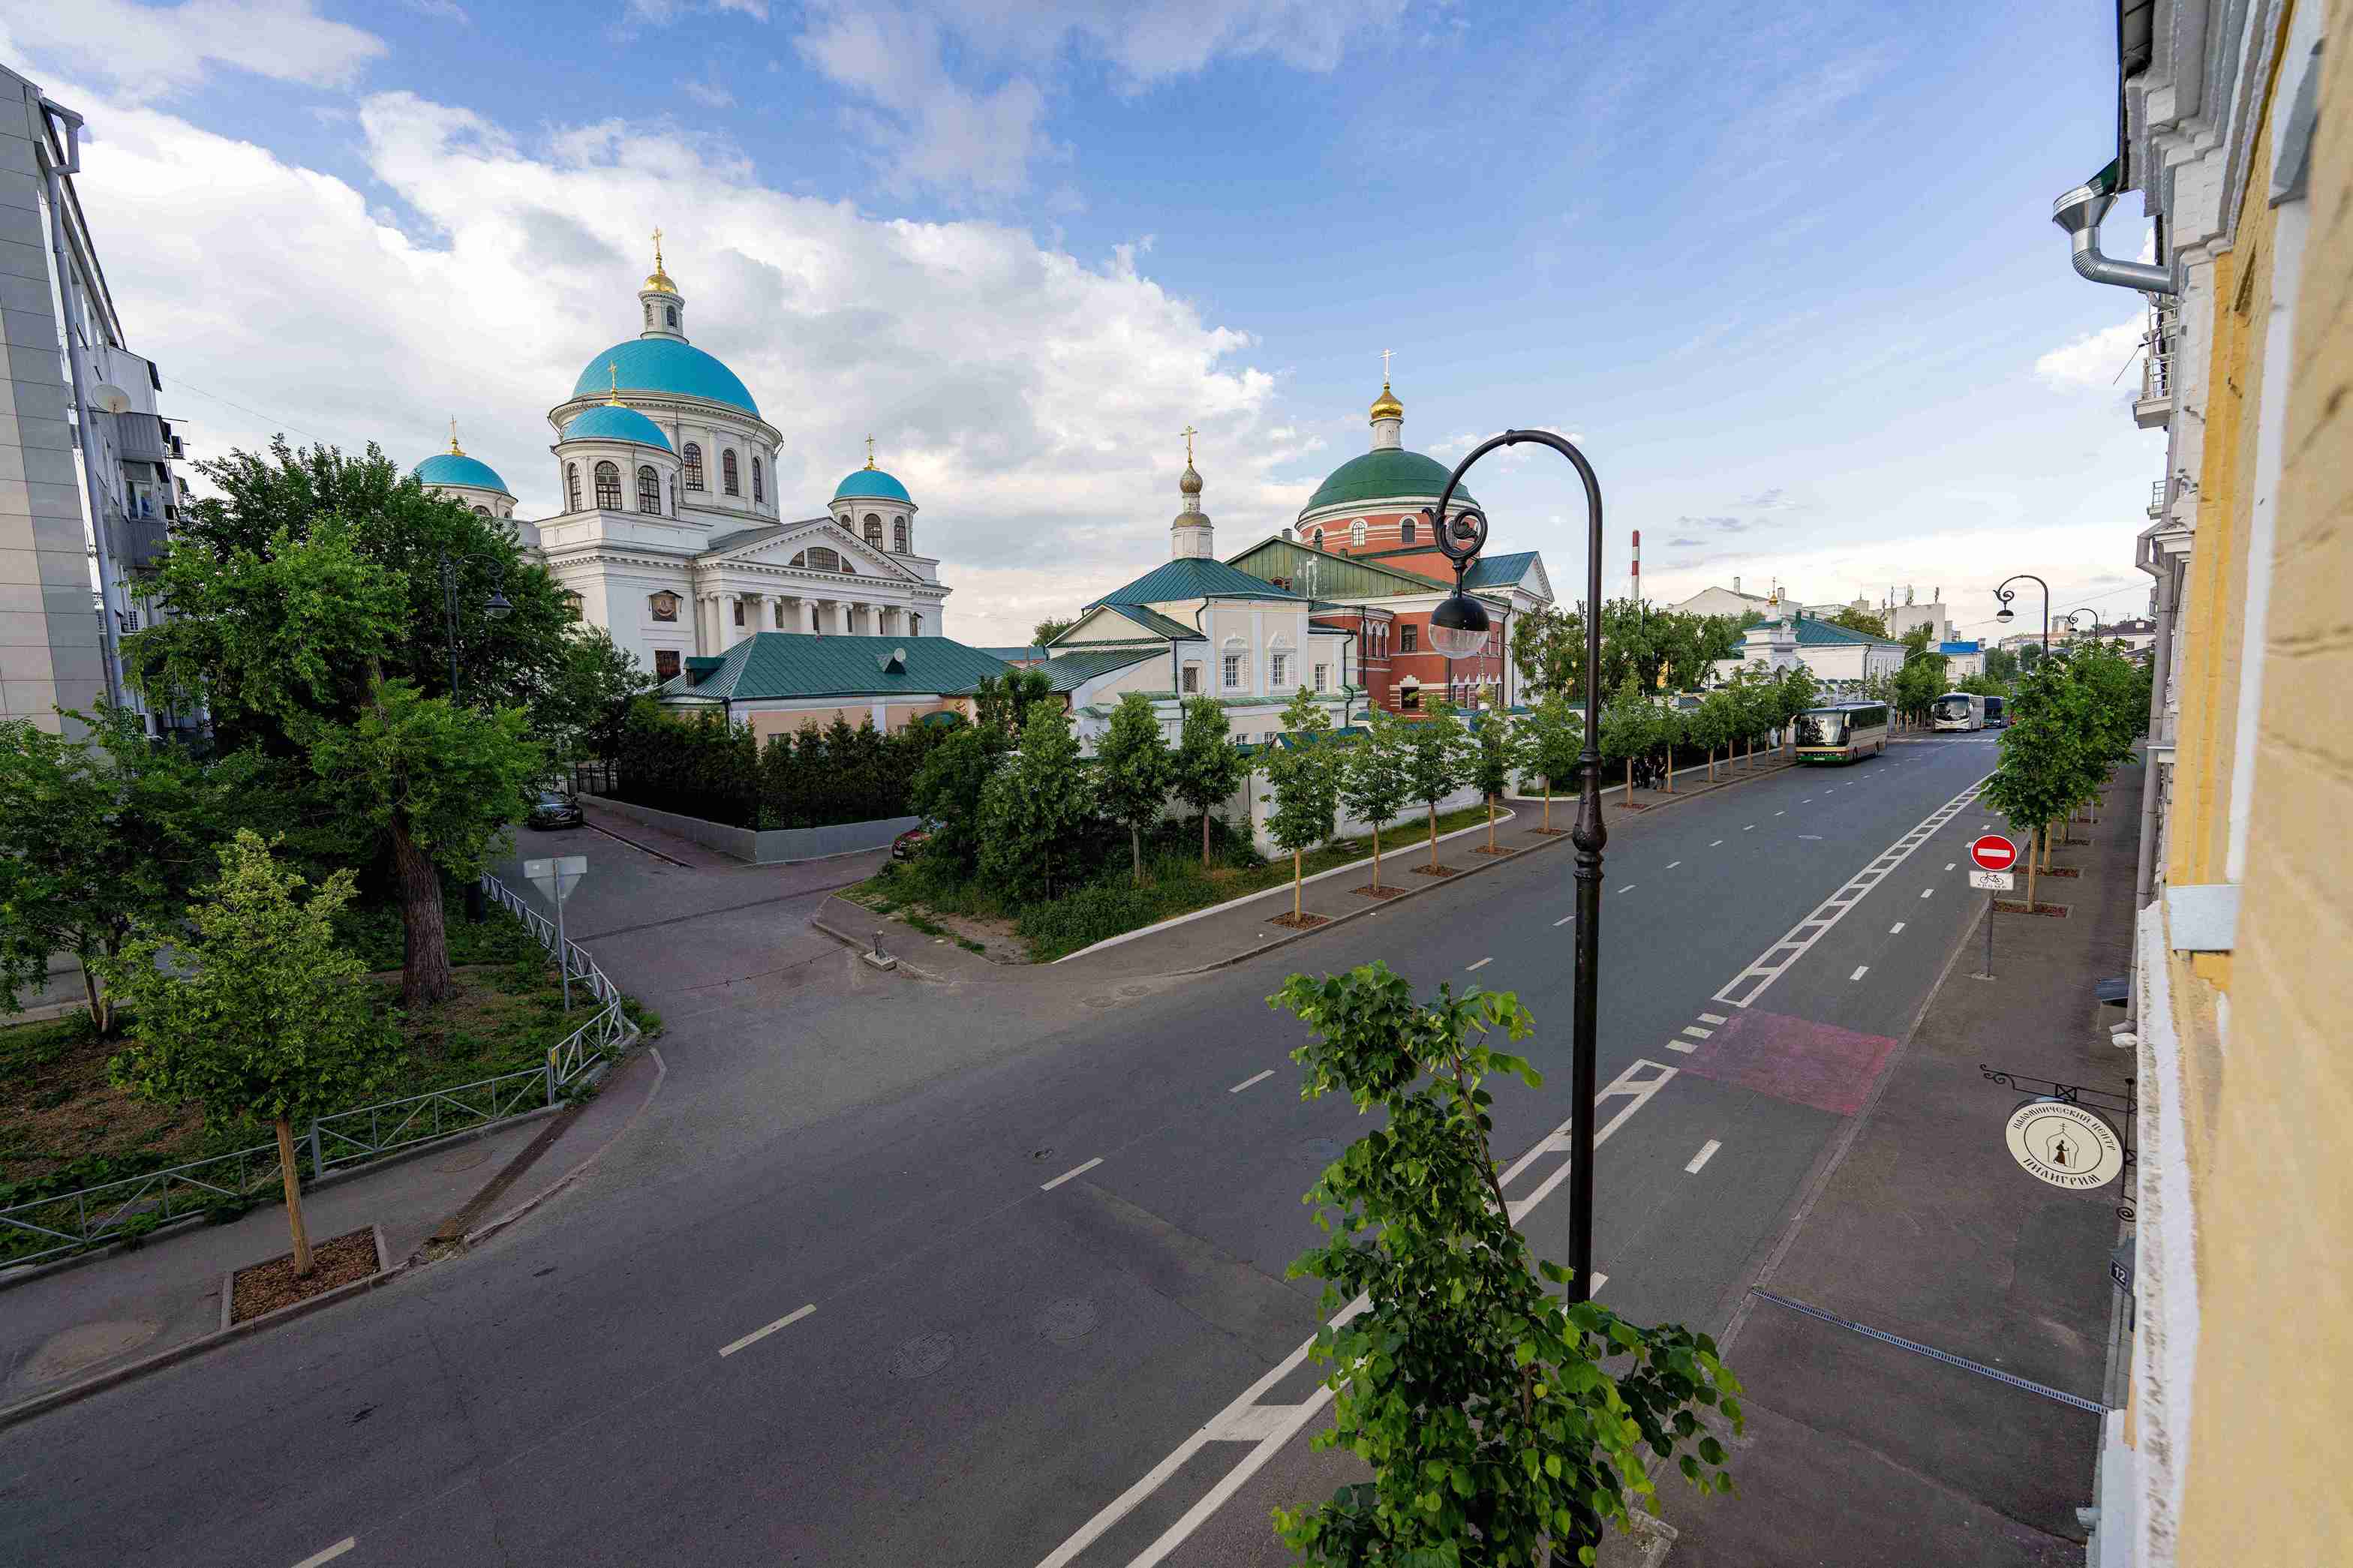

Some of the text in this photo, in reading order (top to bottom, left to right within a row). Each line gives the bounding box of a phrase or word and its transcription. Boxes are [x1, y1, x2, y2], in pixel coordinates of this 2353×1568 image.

[2012, 1105, 2116, 1151] ПАЛОМНИЧЕСКИЙ ЦЕНТР
[2023, 1157, 2101, 1185] ПИЛИГРИМ
[2114, 1266, 2126, 1283] 12
